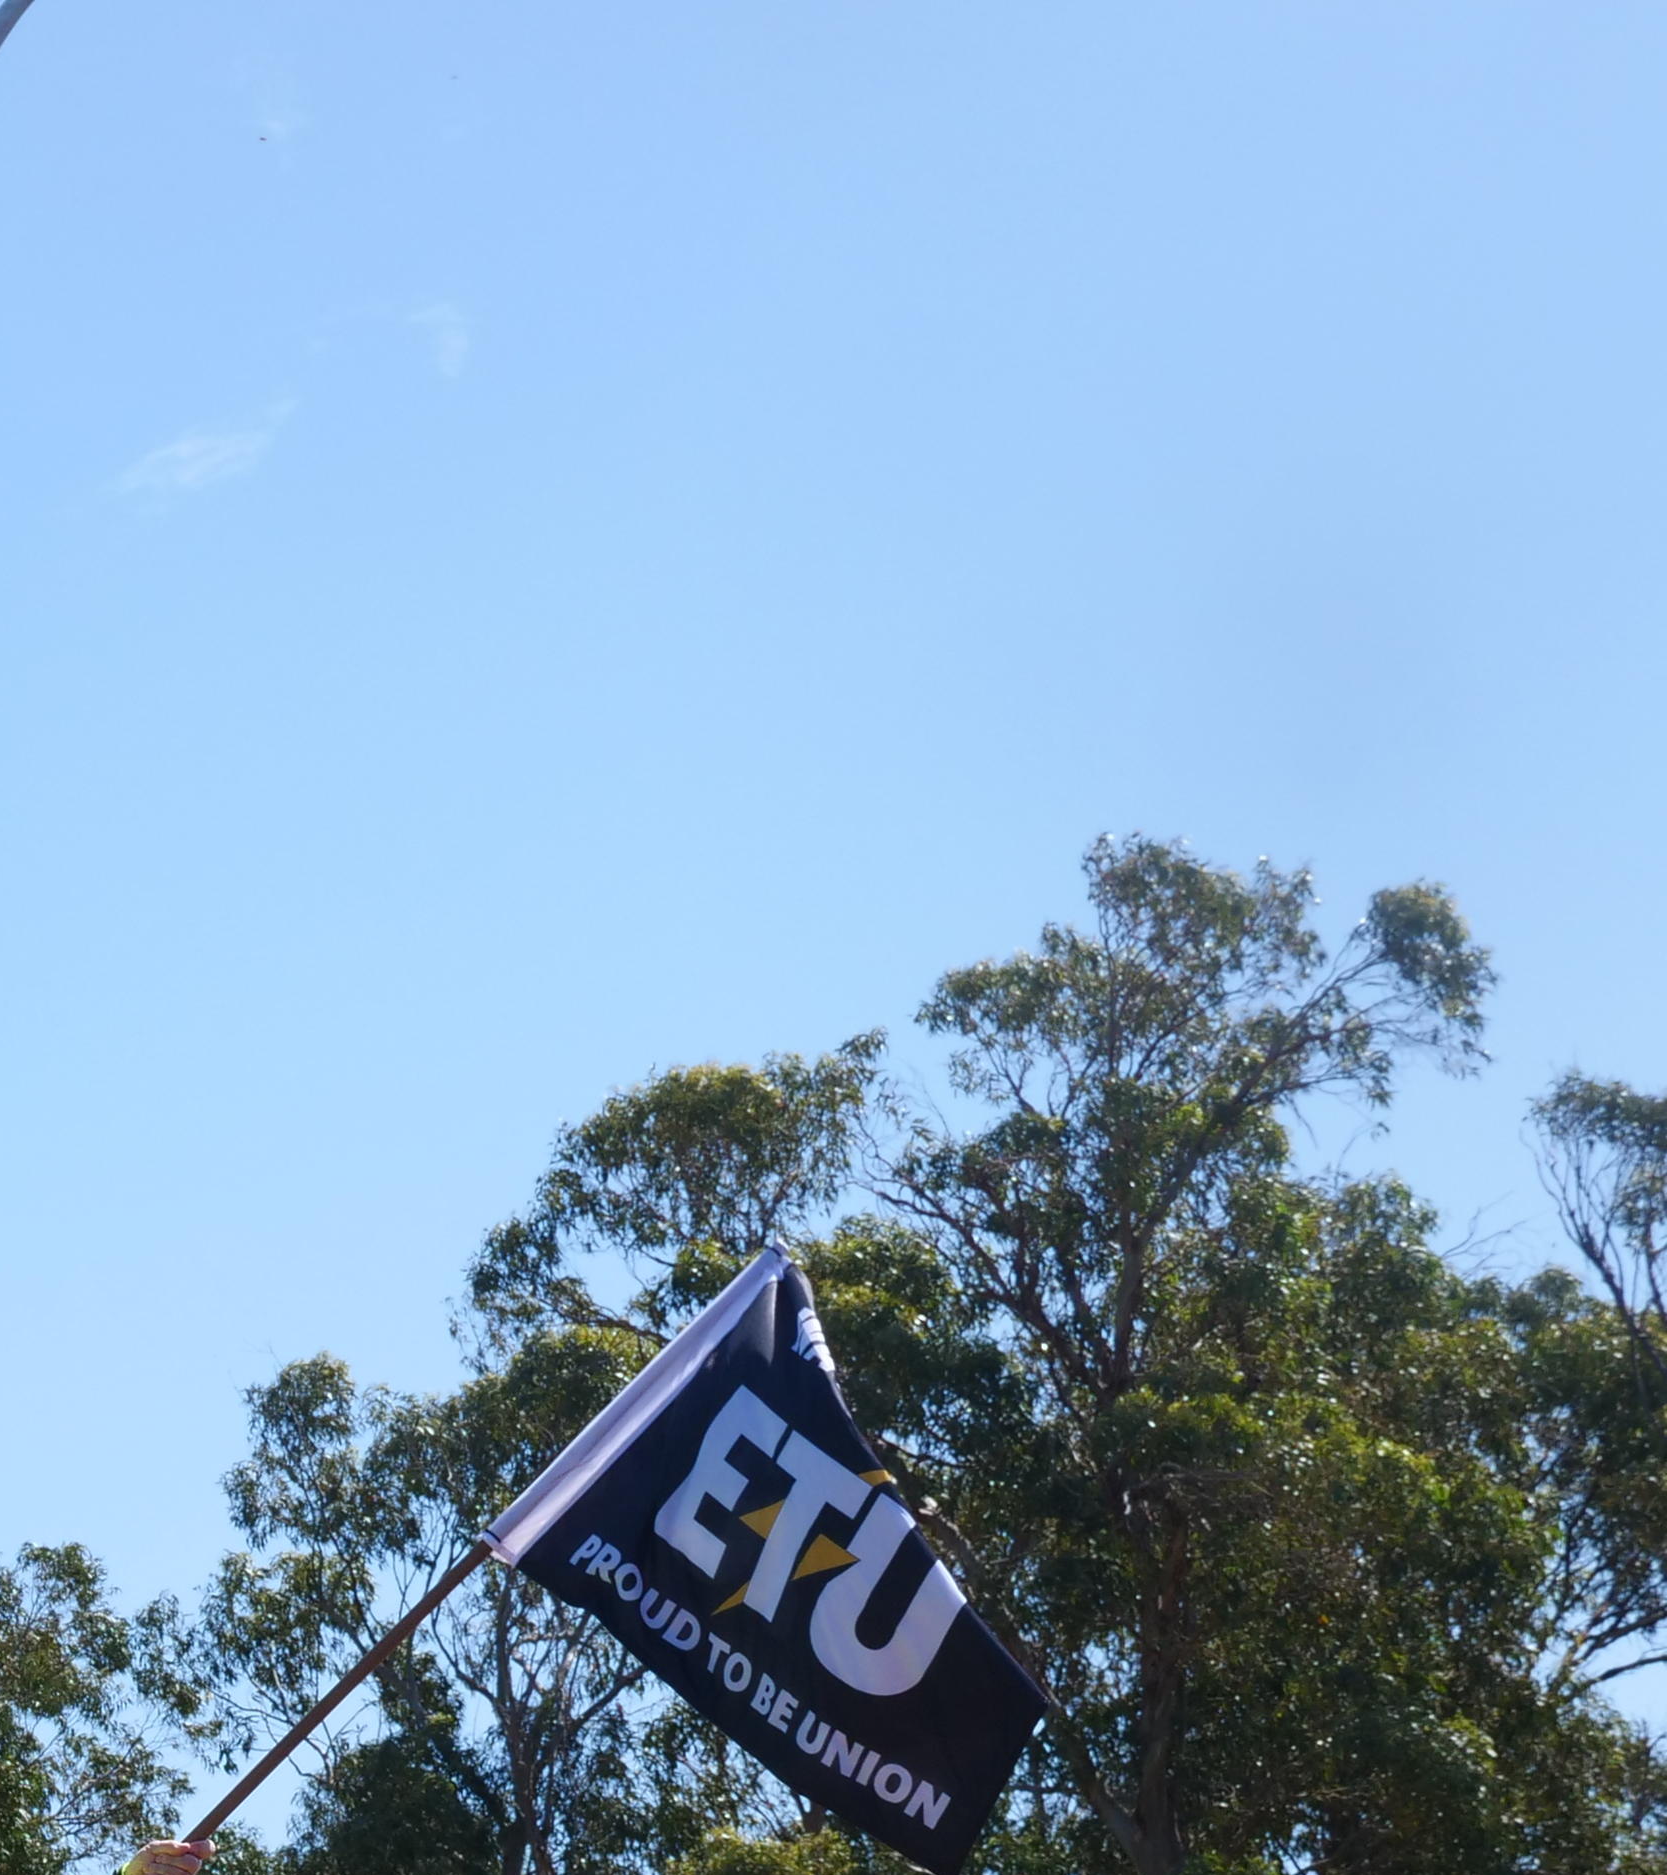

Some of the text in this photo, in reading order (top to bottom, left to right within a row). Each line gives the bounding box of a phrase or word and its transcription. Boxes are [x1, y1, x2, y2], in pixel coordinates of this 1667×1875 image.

[569, 1532, 953, 1831] PROUD TO BE UNION
[652, 1384, 968, 1698] ETU
